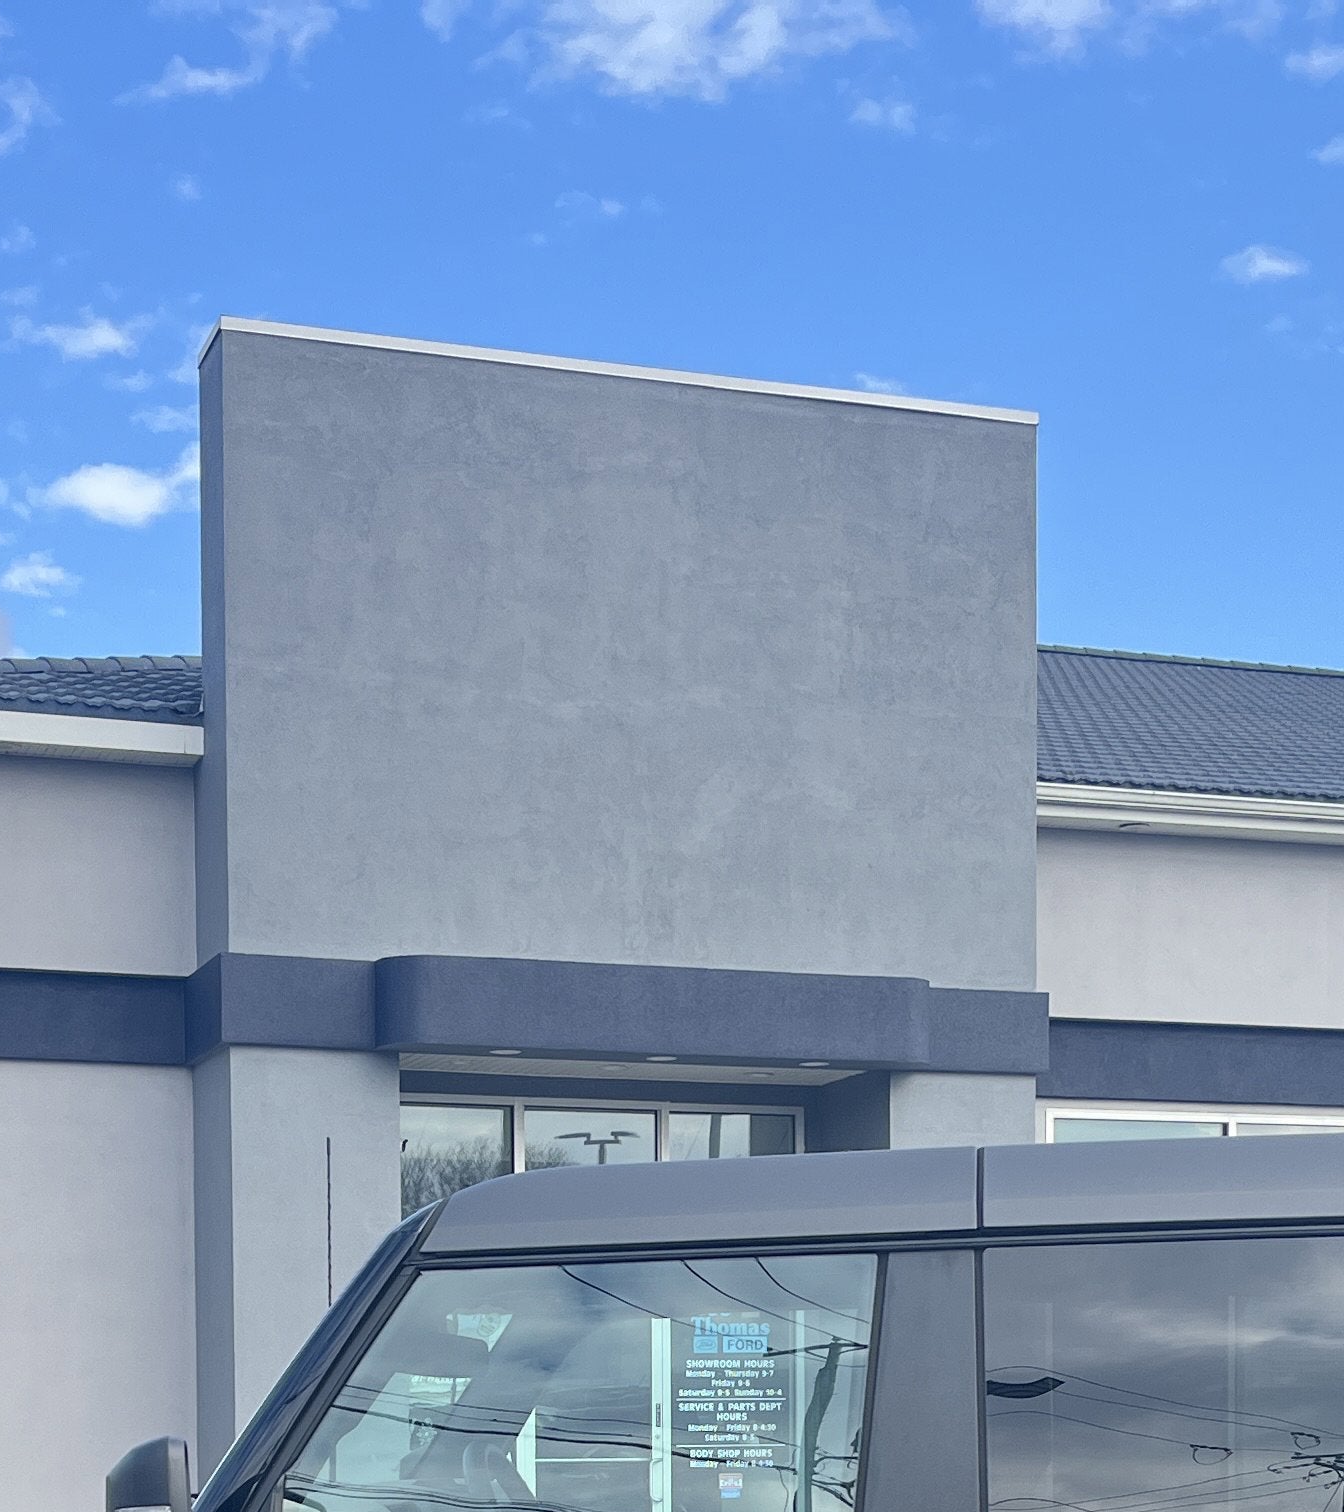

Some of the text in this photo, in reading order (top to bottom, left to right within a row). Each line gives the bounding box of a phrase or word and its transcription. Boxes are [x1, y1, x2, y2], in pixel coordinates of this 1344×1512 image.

[690, 1315, 771, 1336] Thomas
[727, 1339, 764, 1351] FORD
[685, 1359, 776, 1369] SHOWROOM HOURS
[685, 1369, 716, 1379] Monday
[723, 1369, 760, 1379] Thursday
[711, 1379, 736, 1388] Friday
[678, 1388, 716, 1397] Saturday
[734, 1388, 764, 1397] Sunday
[678, 1402, 783, 1412] SERVICE & PARTS DEPT
[716, 1412, 748, 1421] HOURS
[687, 1423, 718, 1432] Monday
[726, 1423, 751, 1432] Friday
[704, 1433, 740, 1442] Saturday
[689, 1448, 773, 1458] BODY SHOP HOURS
